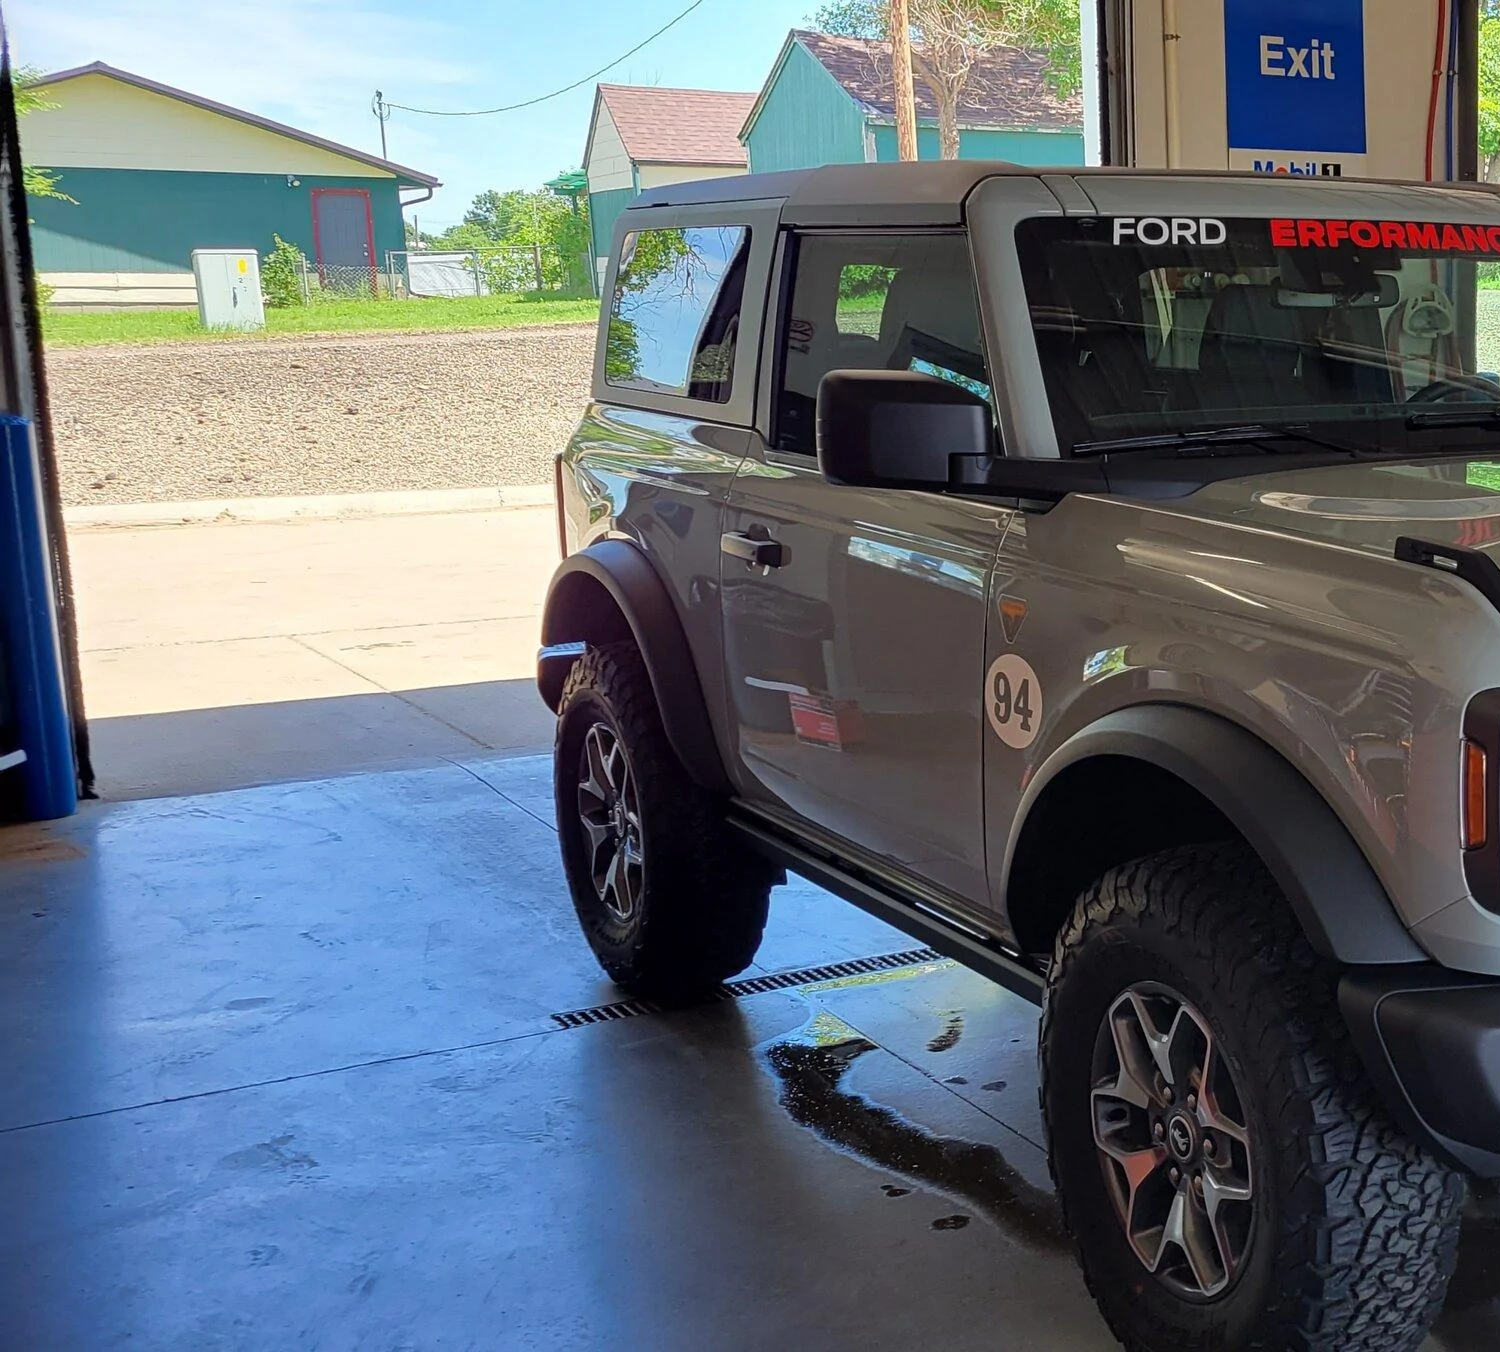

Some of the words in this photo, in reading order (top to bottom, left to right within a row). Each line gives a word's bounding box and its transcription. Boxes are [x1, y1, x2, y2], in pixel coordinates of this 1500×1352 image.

[1260, 35, 1336, 80] Exit
[1113, 217, 1227, 246] FORD
[994, 671, 1034, 732] 94
